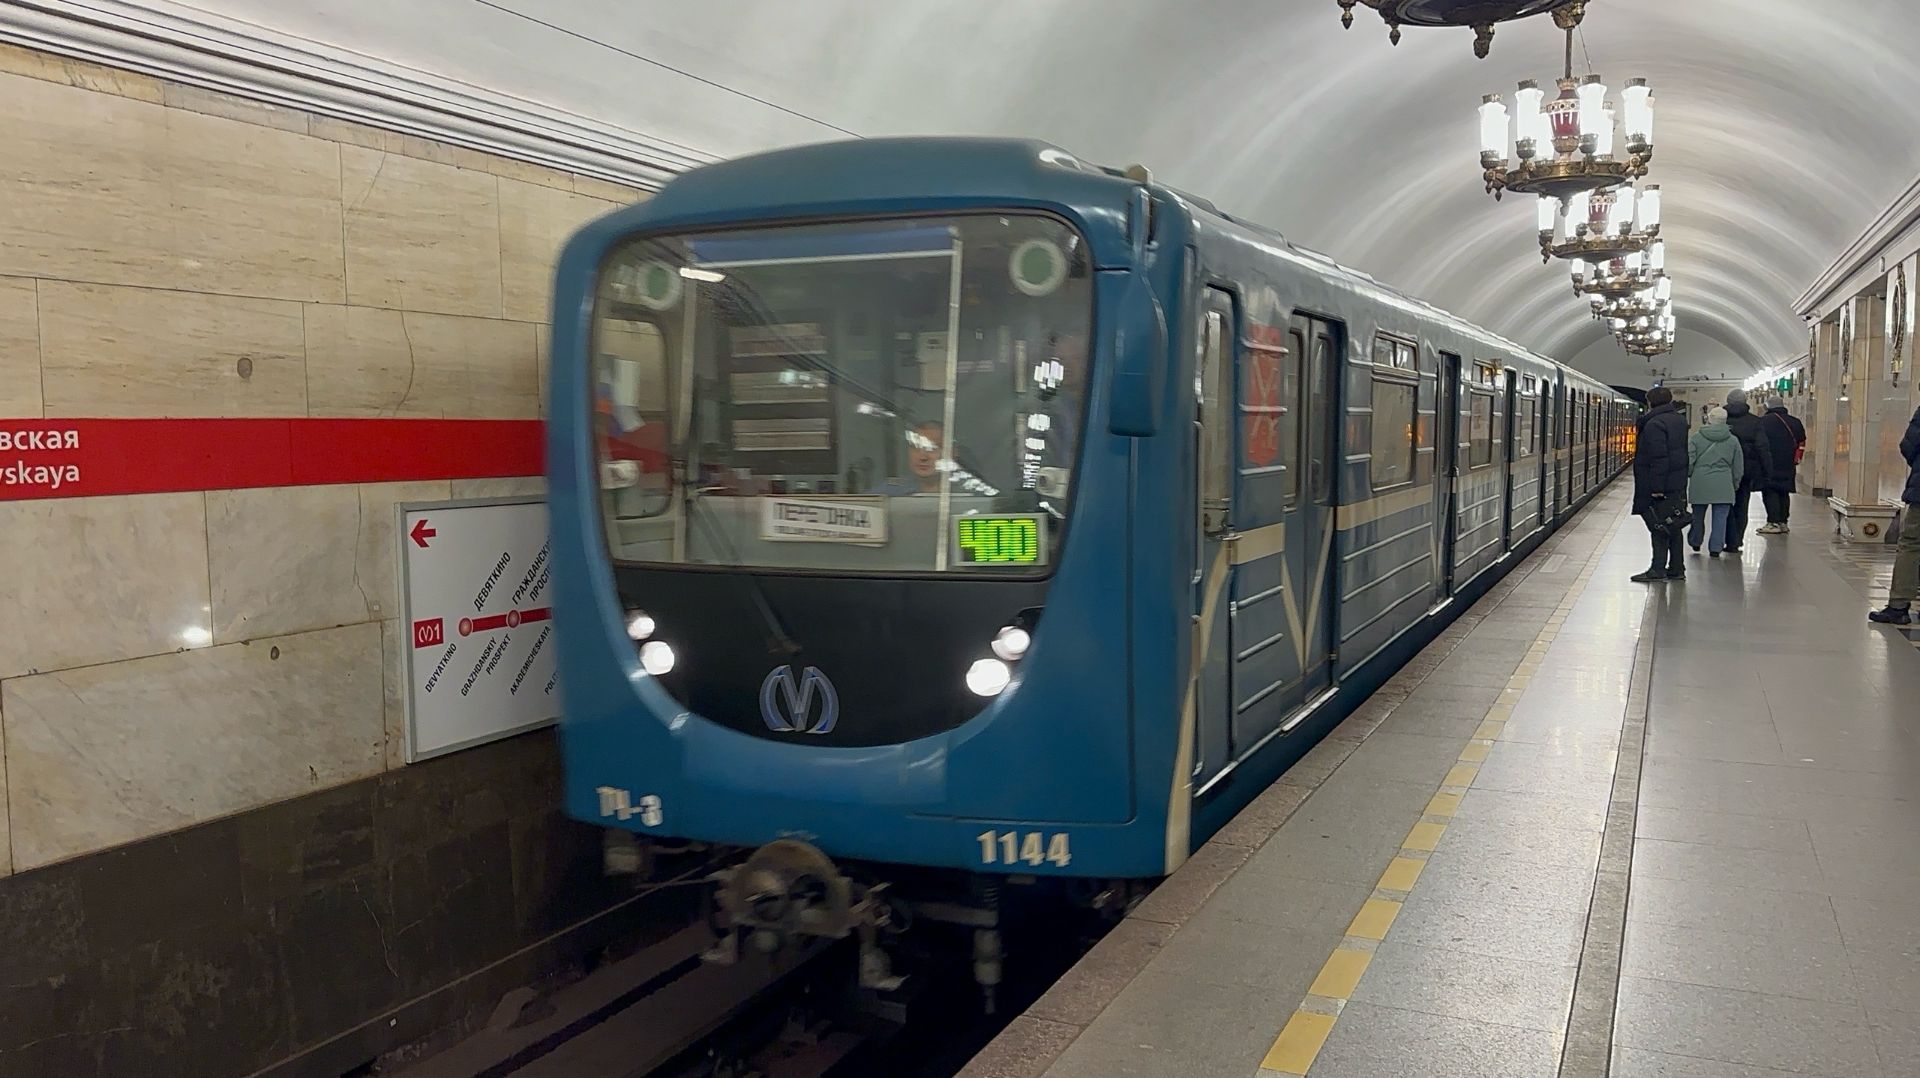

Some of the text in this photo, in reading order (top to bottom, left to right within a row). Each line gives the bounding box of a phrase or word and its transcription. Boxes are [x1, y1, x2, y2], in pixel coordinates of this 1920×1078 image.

[0, 430, 79, 450] вская
[474, 552, 511, 612] ДЕВЯТКИНО
[530, 564, 551, 602] ПРОСП
[425, 643, 457, 693] DEVYATKINO
[461, 637, 497, 697] GRAZHDANSKIY
[485, 633, 511, 676] PROSPEKT
[510, 625, 551, 696] AKADEMICHESKAYA
[976, 829, 1072, 867] 1144
